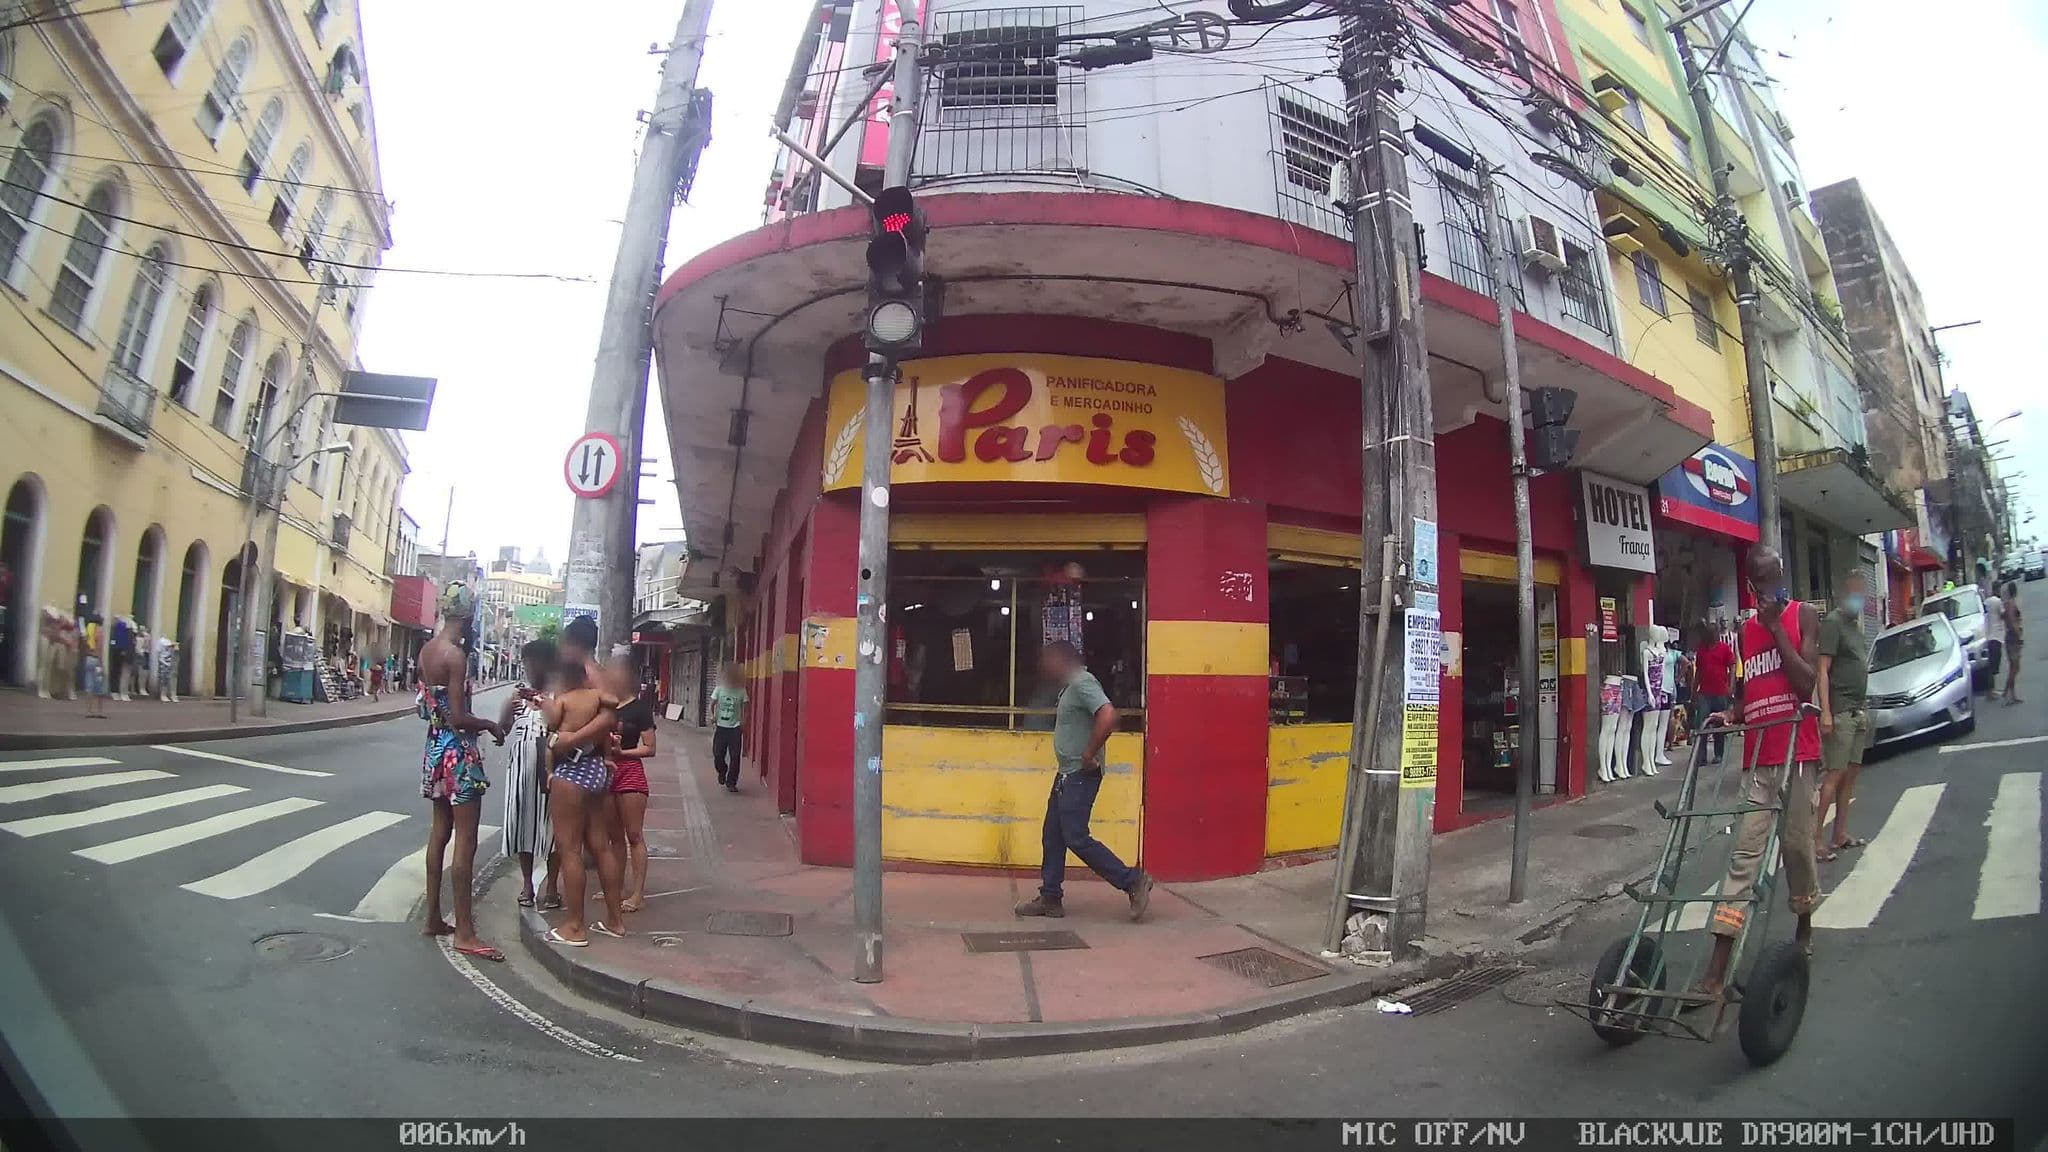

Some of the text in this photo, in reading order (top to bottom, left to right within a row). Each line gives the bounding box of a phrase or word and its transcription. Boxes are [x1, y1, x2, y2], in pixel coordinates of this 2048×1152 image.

[1046, 376, 1157, 397] PANIFICADORA
[938, 367, 1157, 466] Paris
[1050, 395, 1153, 414] E MERCADINHO
[1589, 482, 1648, 532] HOTEL
[1619, 535, 1650, 560] França
